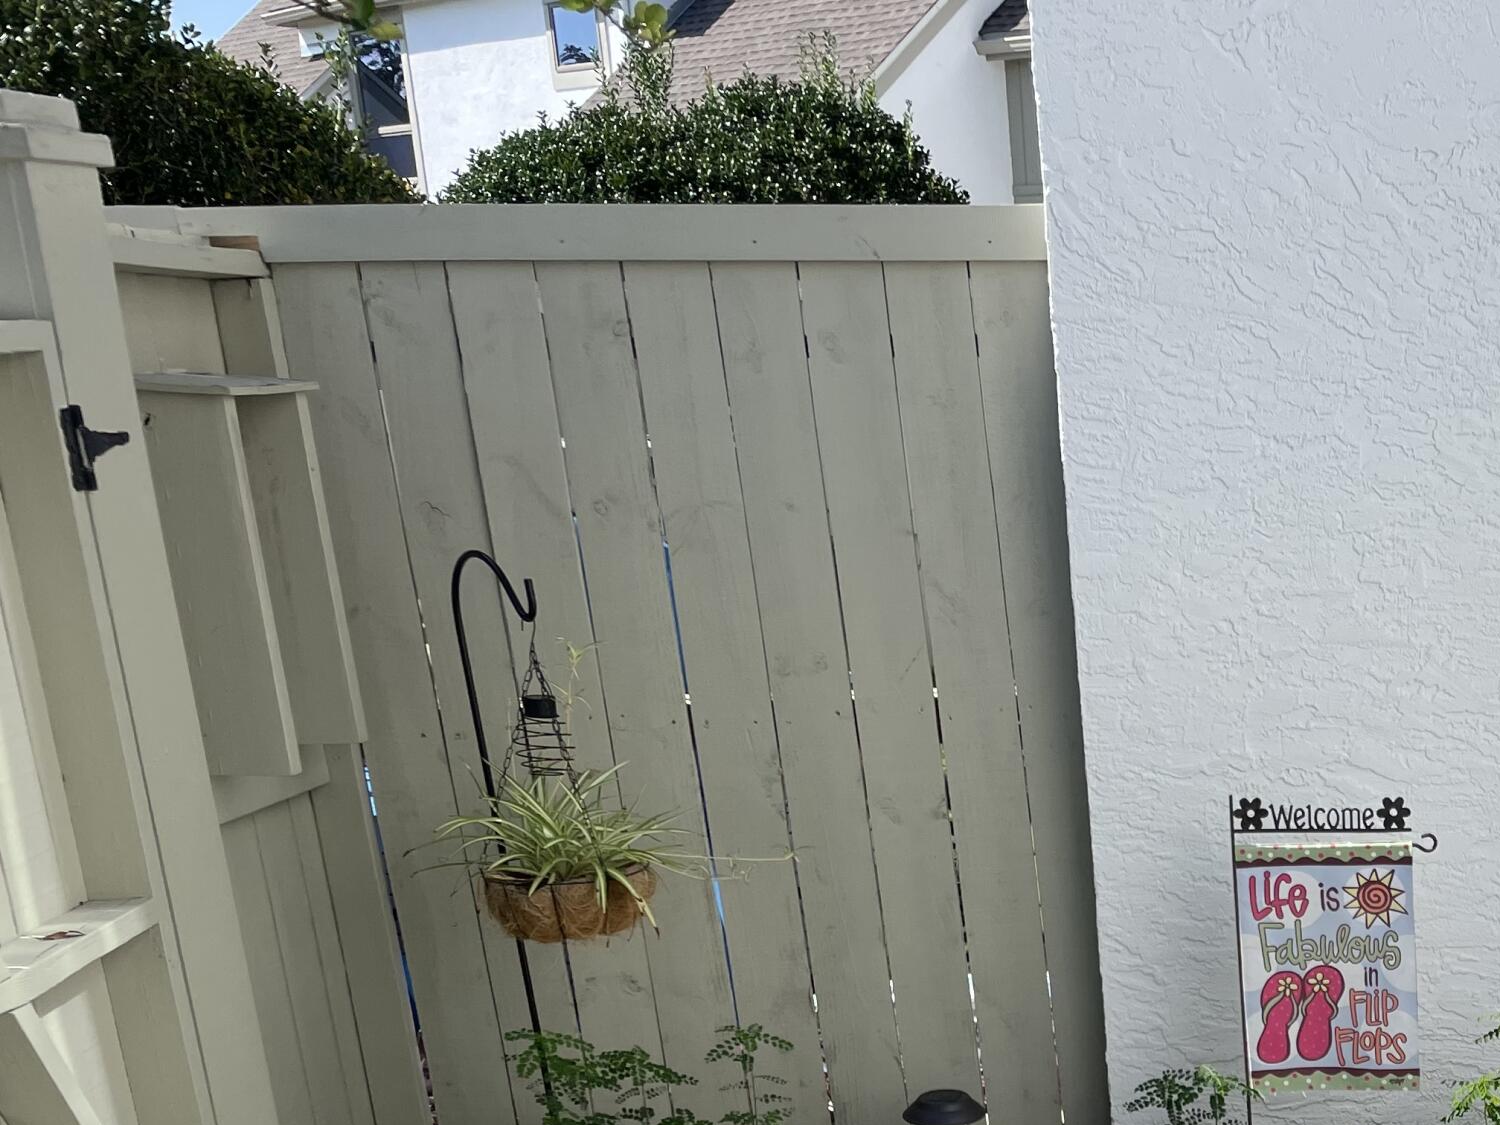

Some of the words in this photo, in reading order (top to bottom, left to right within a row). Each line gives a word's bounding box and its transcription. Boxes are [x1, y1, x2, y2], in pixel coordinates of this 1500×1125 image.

[1269, 804, 1375, 830] Welcome
[1249, 870, 1309, 921] Life
[1318, 882, 1340, 912] is
[1257, 919, 1401, 972] Fabulous
[1363, 966, 1379, 987] in
